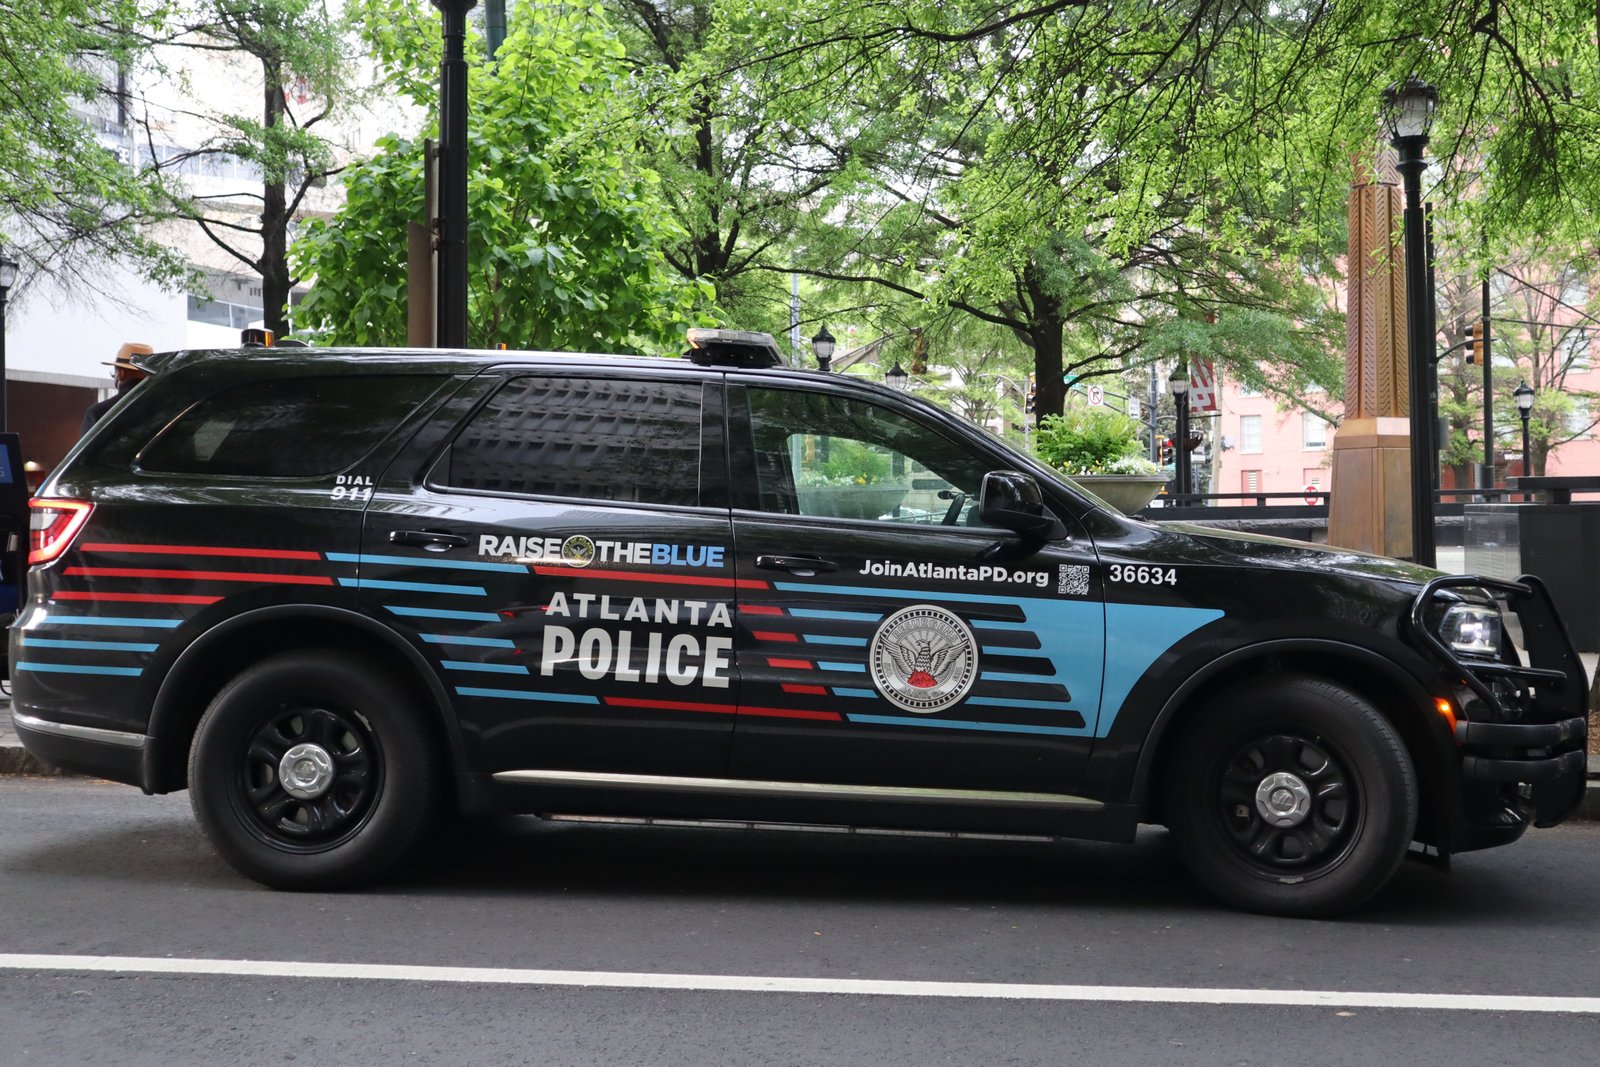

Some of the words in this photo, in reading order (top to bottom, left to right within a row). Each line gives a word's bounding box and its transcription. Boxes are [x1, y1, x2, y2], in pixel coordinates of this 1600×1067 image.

[330, 486, 372, 501] 911
[336, 475, 373, 486] DIAL
[478, 534, 562, 560] RAISE
[859, 560, 1049, 587] JoinAtlantaPD.org
[1109, 564, 1177, 585] 36634
[545, 591, 733, 628] ATLANTA
[892, 617, 959, 643] RESURGENS
[540, 625, 732, 689] POLICE
